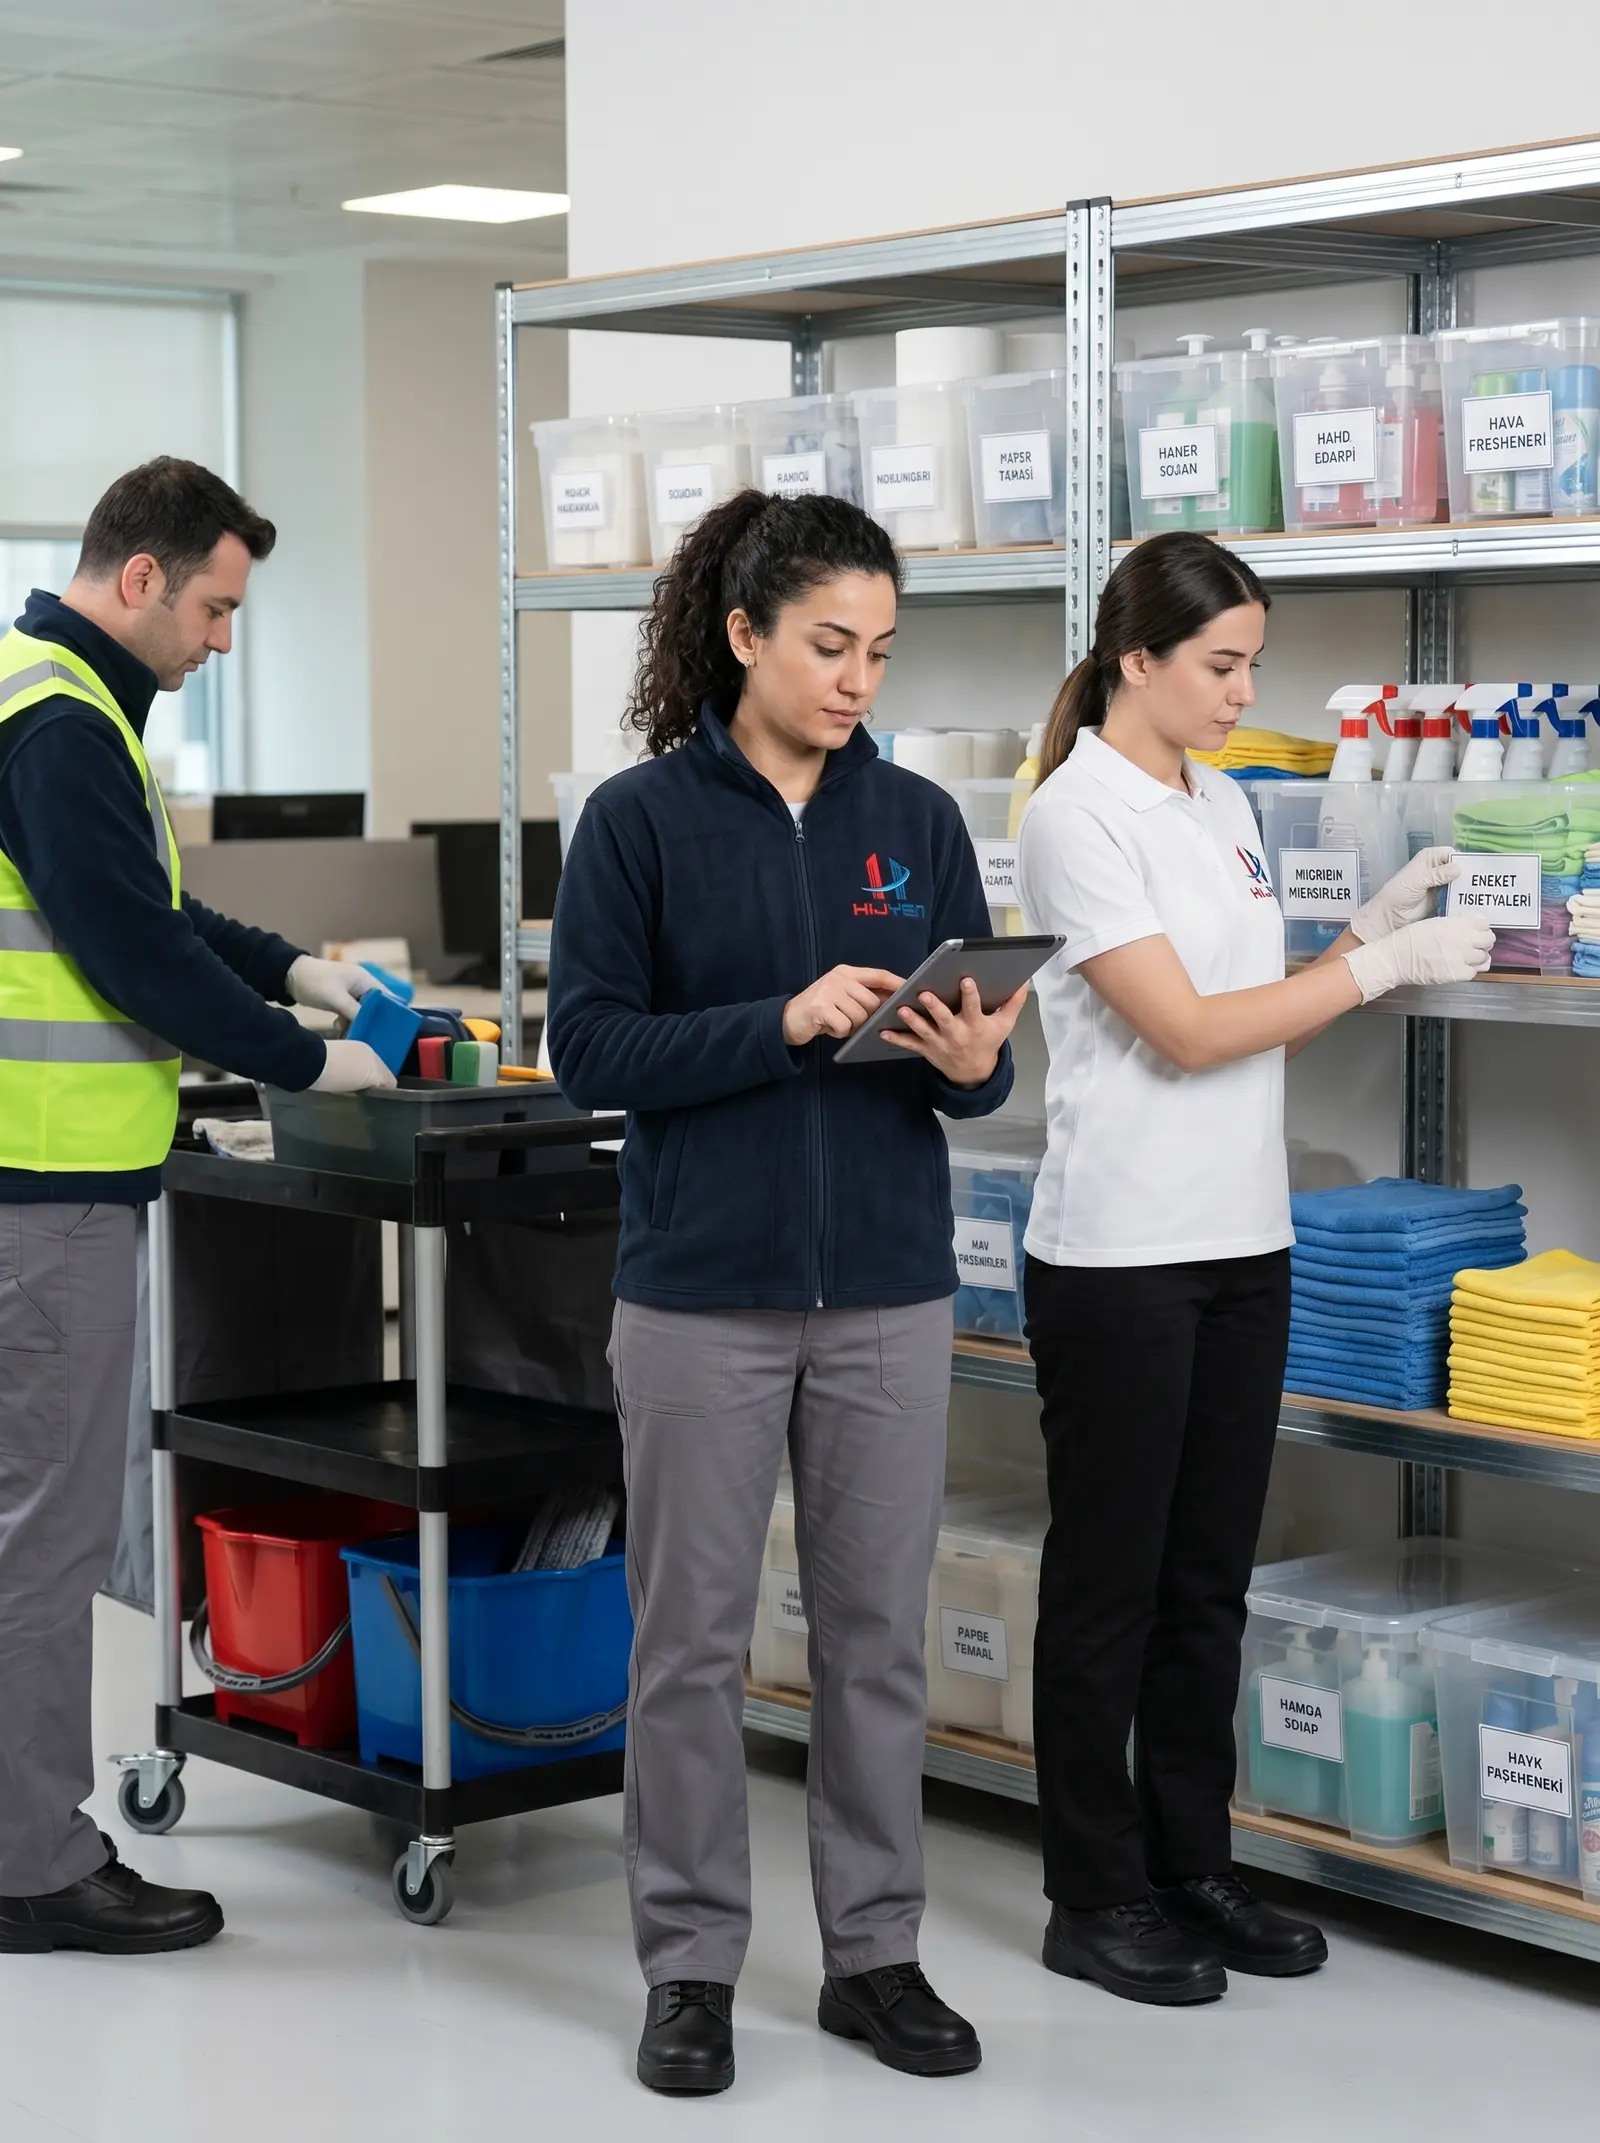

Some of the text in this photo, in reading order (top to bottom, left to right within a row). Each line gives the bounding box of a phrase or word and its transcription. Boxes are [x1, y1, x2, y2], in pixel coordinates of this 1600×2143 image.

[1489, 415, 1525, 430] HAVA
[1469, 432, 1547, 452] FRESHENERİ
[1158, 444, 1198, 460] HANER
[1471, 874, 1517, 888] ENEKET
[971, 1239, 989, 1251] MAV
[1284, 1717, 1319, 1735] SDIAP
[1508, 1751, 1543, 1770] HAYK
